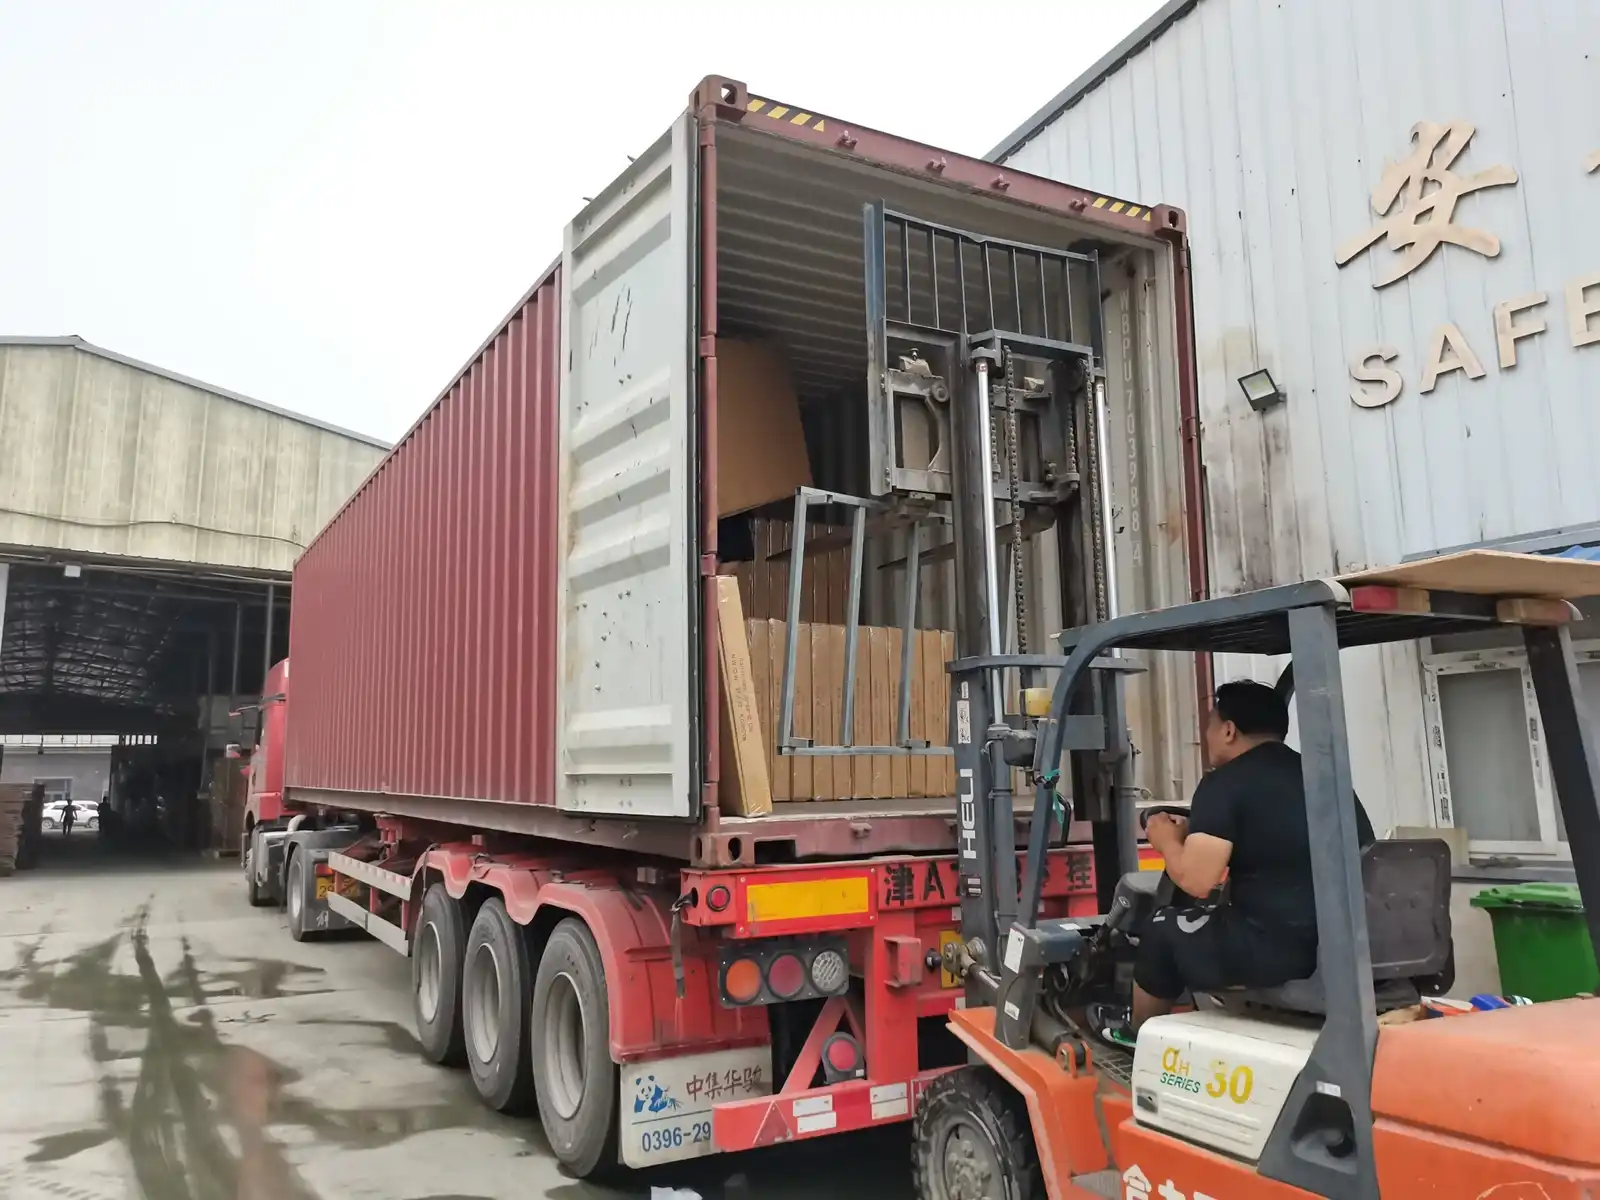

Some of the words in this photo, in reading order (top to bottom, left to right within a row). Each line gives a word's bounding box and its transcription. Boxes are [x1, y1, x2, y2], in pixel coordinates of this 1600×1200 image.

[1335, 119, 1600, 289] 安
[960, 768, 977, 859] HELI
[1160, 1072, 1201, 1094] SERIES
[1205, 1058, 1254, 1104] 30
